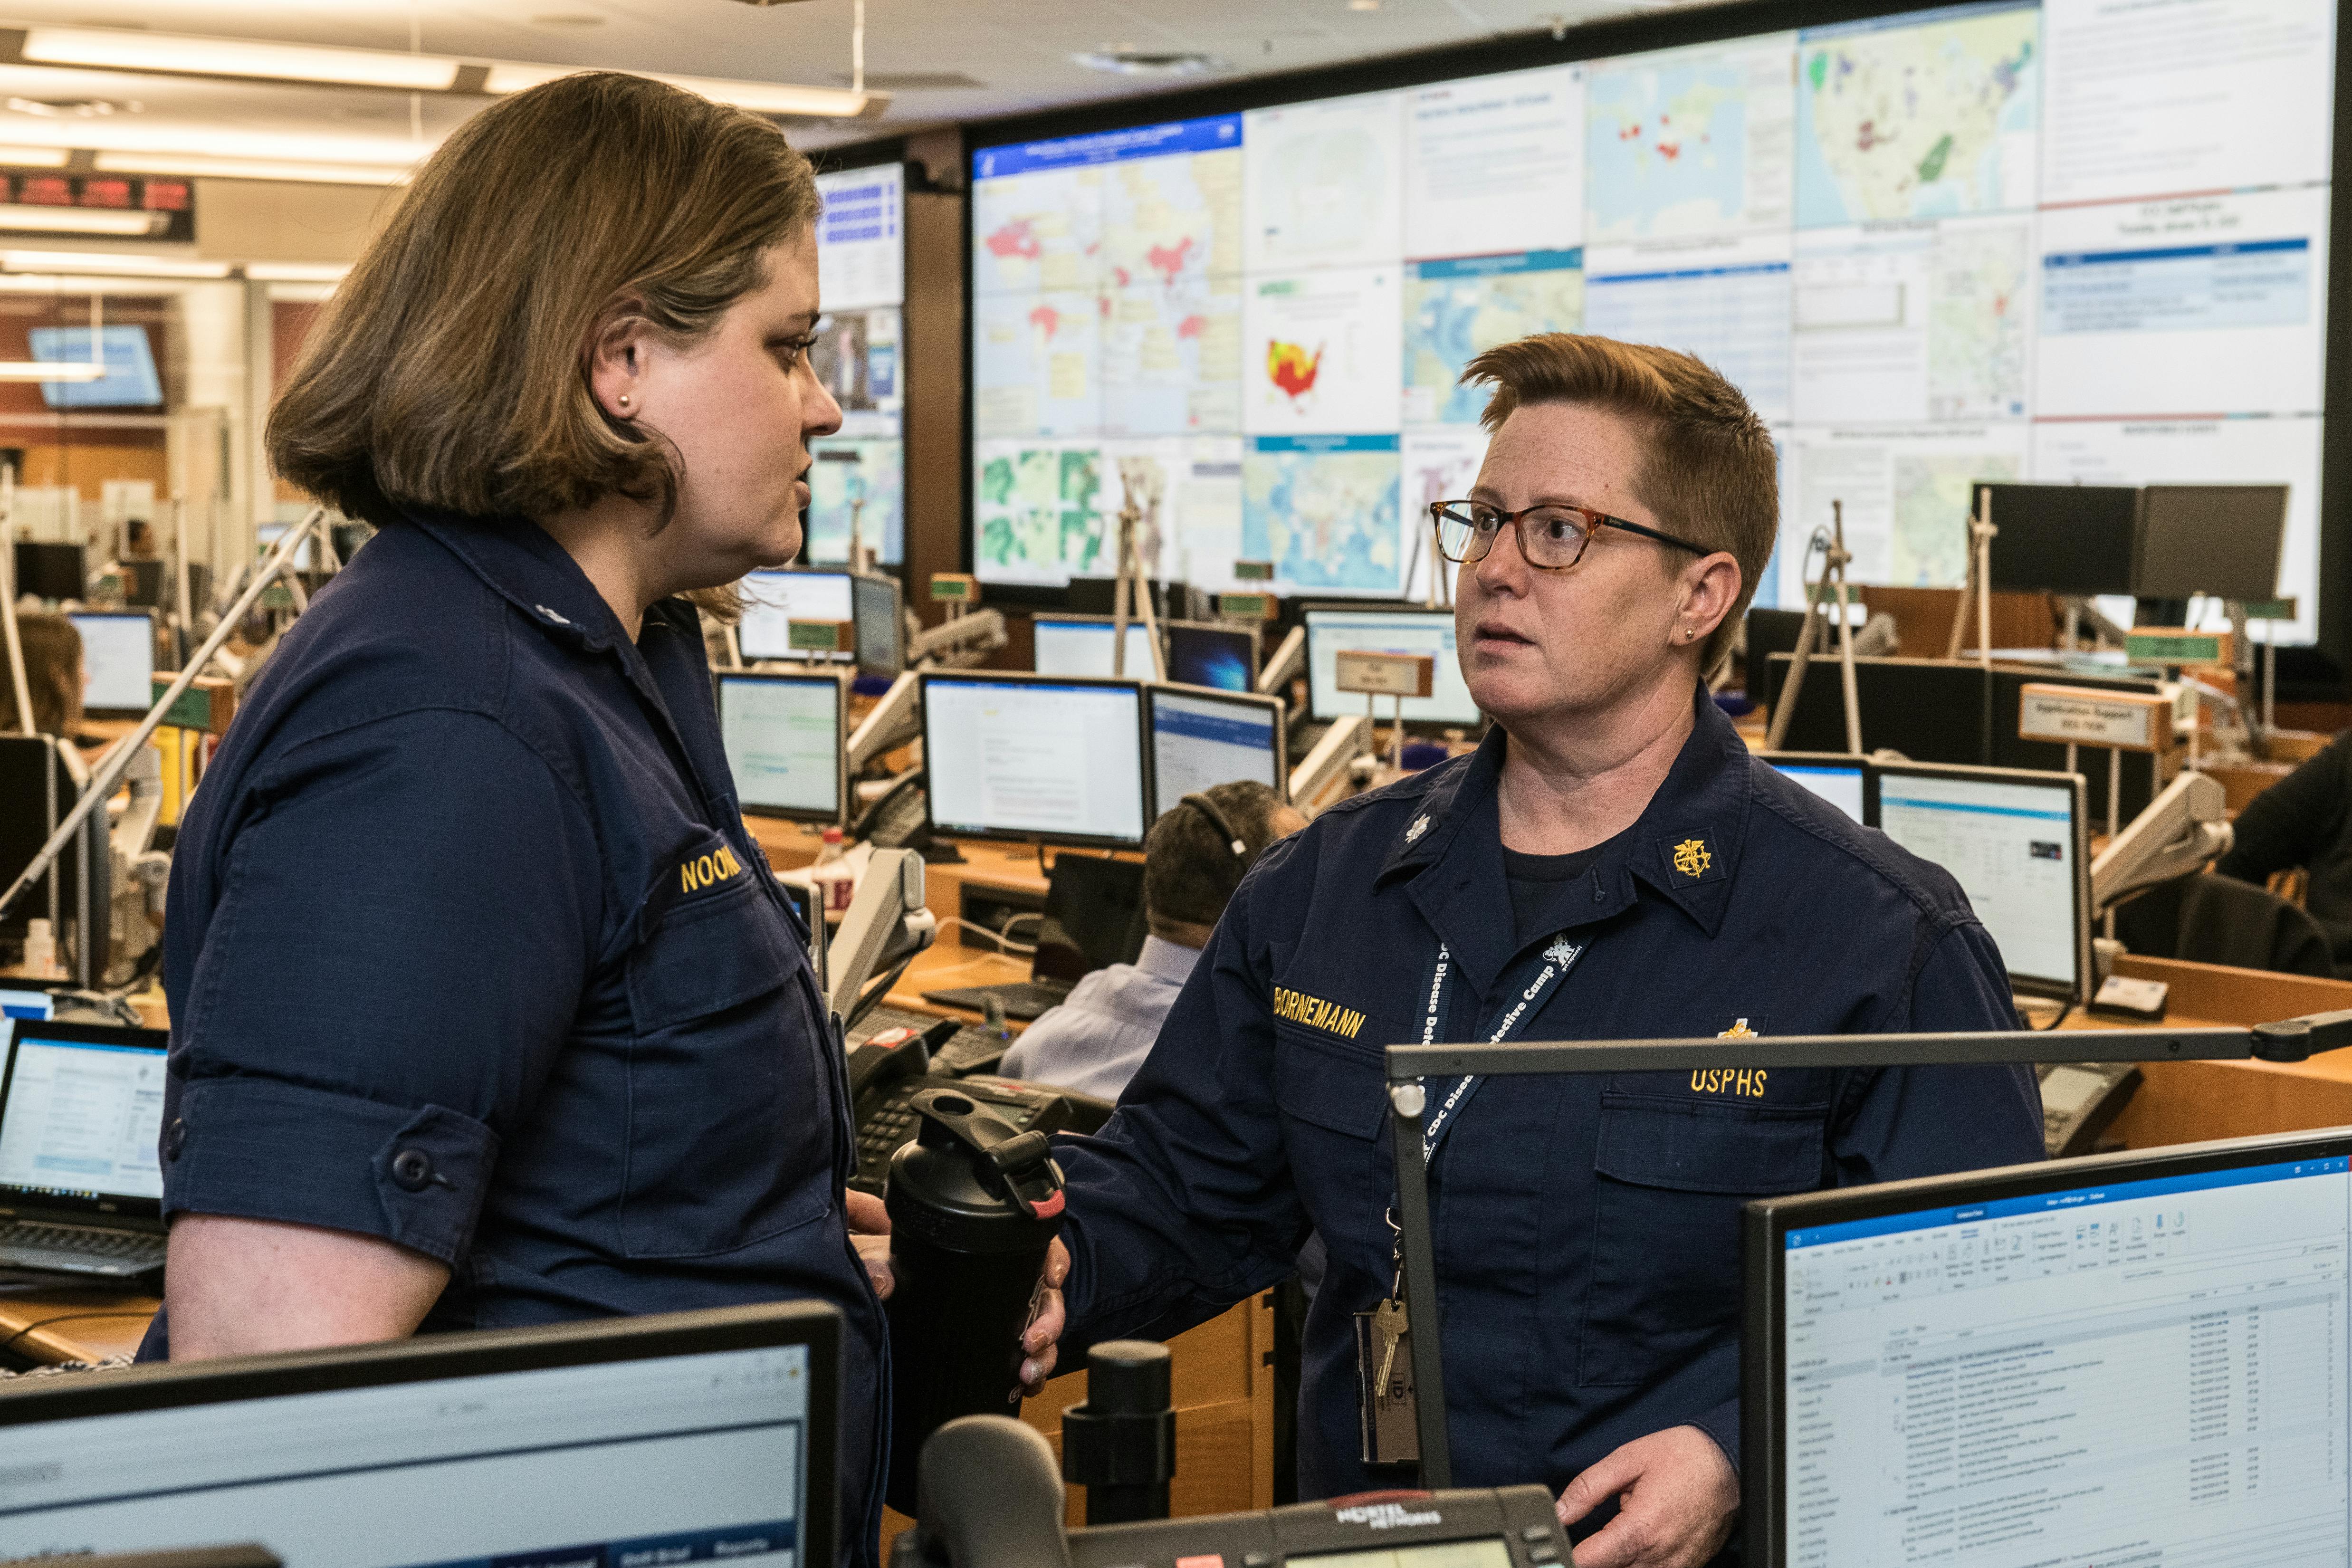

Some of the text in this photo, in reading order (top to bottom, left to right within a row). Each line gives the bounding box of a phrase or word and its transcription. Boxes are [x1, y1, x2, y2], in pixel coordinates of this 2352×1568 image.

[1274, 987, 1367, 1039] BORNEMANN
[1428, 963, 1446, 1014] Disease
[1427, 1109, 1447, 1137] CDC
[1444, 1075, 1474, 1109] Disea
[1523, 965, 1555, 1002] Camp
[1691, 1069, 1767, 1098] USPHS
